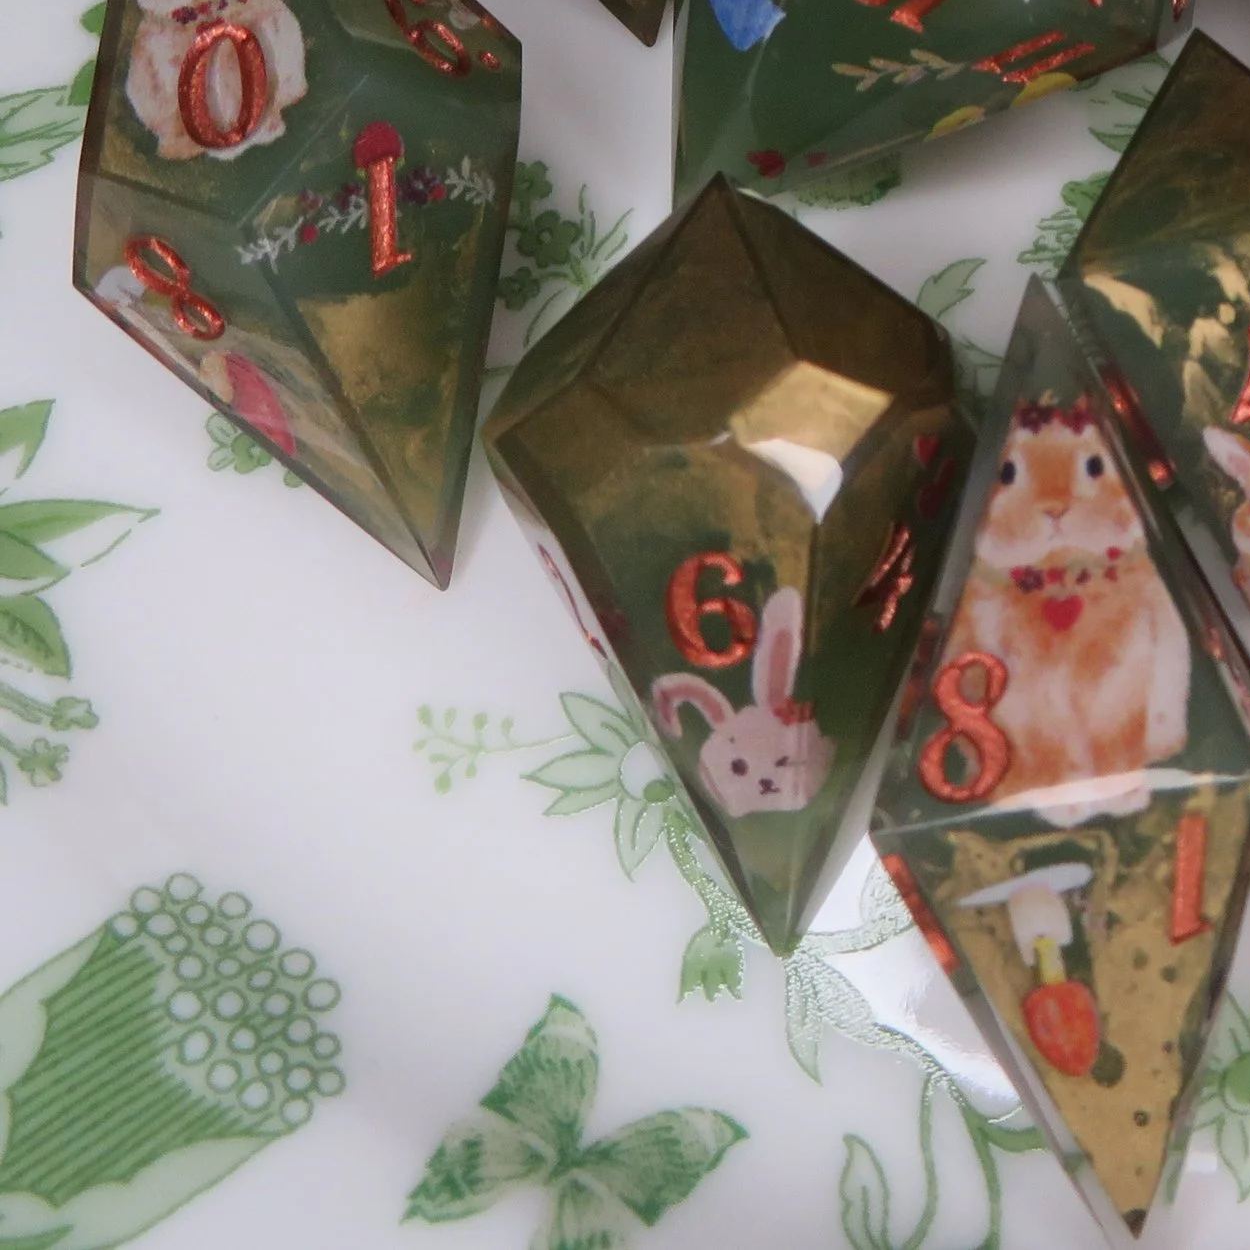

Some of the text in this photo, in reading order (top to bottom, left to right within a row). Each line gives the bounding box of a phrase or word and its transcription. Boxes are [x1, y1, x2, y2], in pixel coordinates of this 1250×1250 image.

[178, 18, 268, 149] 0
[366, 152, 413, 280] 1
[122, 233, 226, 342] 8
[664, 550, 757, 669] 6
[917, 650, 1012, 804] 8
[1169, 810, 1214, 946] 1
